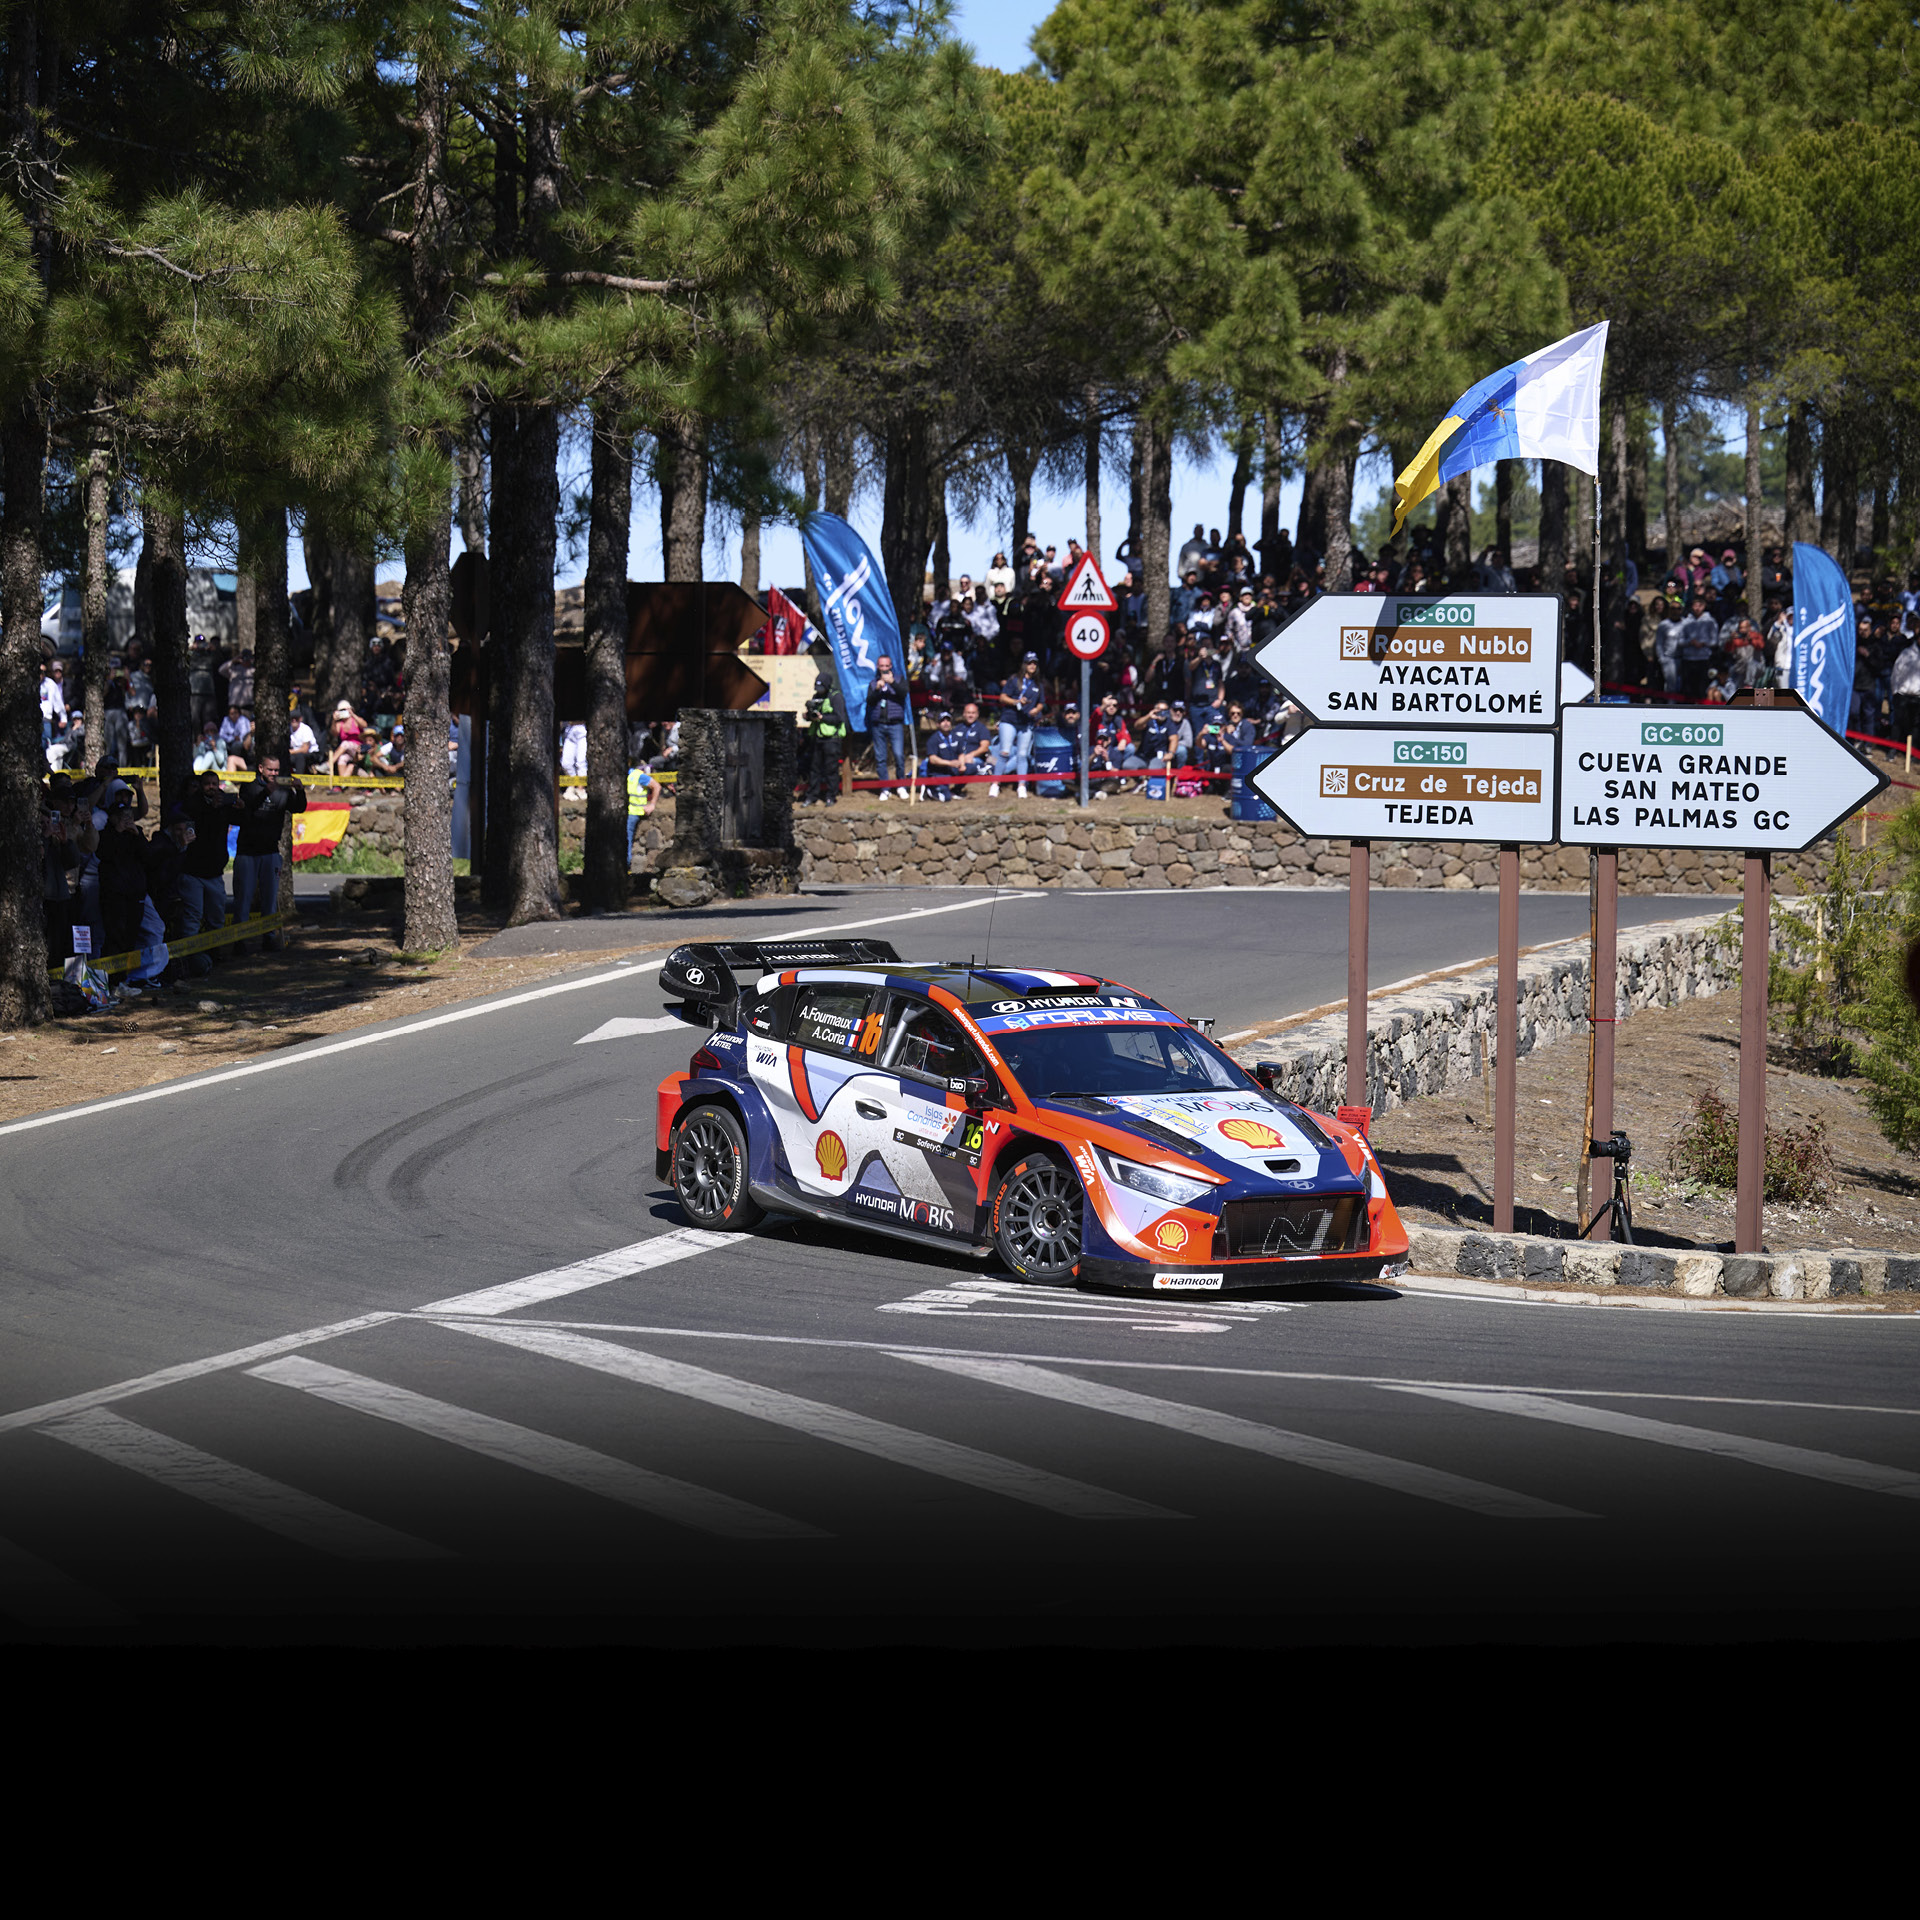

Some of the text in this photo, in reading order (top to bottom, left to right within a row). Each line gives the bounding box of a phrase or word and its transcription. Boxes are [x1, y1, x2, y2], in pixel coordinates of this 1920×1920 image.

[1399, 606, 1473, 624] GC-600
[1075, 628, 1101, 644] 40
[1374, 633, 1529, 658] Roque Nublo
[1378, 665, 1491, 687] AYACATA
[1327, 690, 1543, 714] SAN BARTOLOMÉ
[1644, 725, 1720, 743] GC-600
[1396, 744, 1465, 762] GC-150
[1578, 751, 1788, 776] CUEVA GRANDE
[1354, 772, 1538, 797] Cruz de Tejeda
[1604, 779, 1760, 803] SAN MATEO
[1384, 803, 1474, 826] TEJEDA
[1573, 805, 1790, 831] LAS PALMAS GC
[1026, 996, 1105, 1009] HYUNDAI
[799, 1005, 853, 1030] A.Fourmaux
[1025, 1010, 1157, 1025] FORUM8
[811, 1025, 846, 1045] A.Coria
[858, 1012, 885, 1055] 16
[952, 1007, 1000, 1067] motorsport.hyundai.com
[756, 1052, 778, 1067] WIA
[925, 1105, 943, 1120] Islas
[1175, 1101, 1274, 1113] MOBIS
[907, 1110, 942, 1130] Canarias
[965, 1123, 984, 1149] 16
[855, 1192, 954, 1231] HYUNDAI MOBIS
